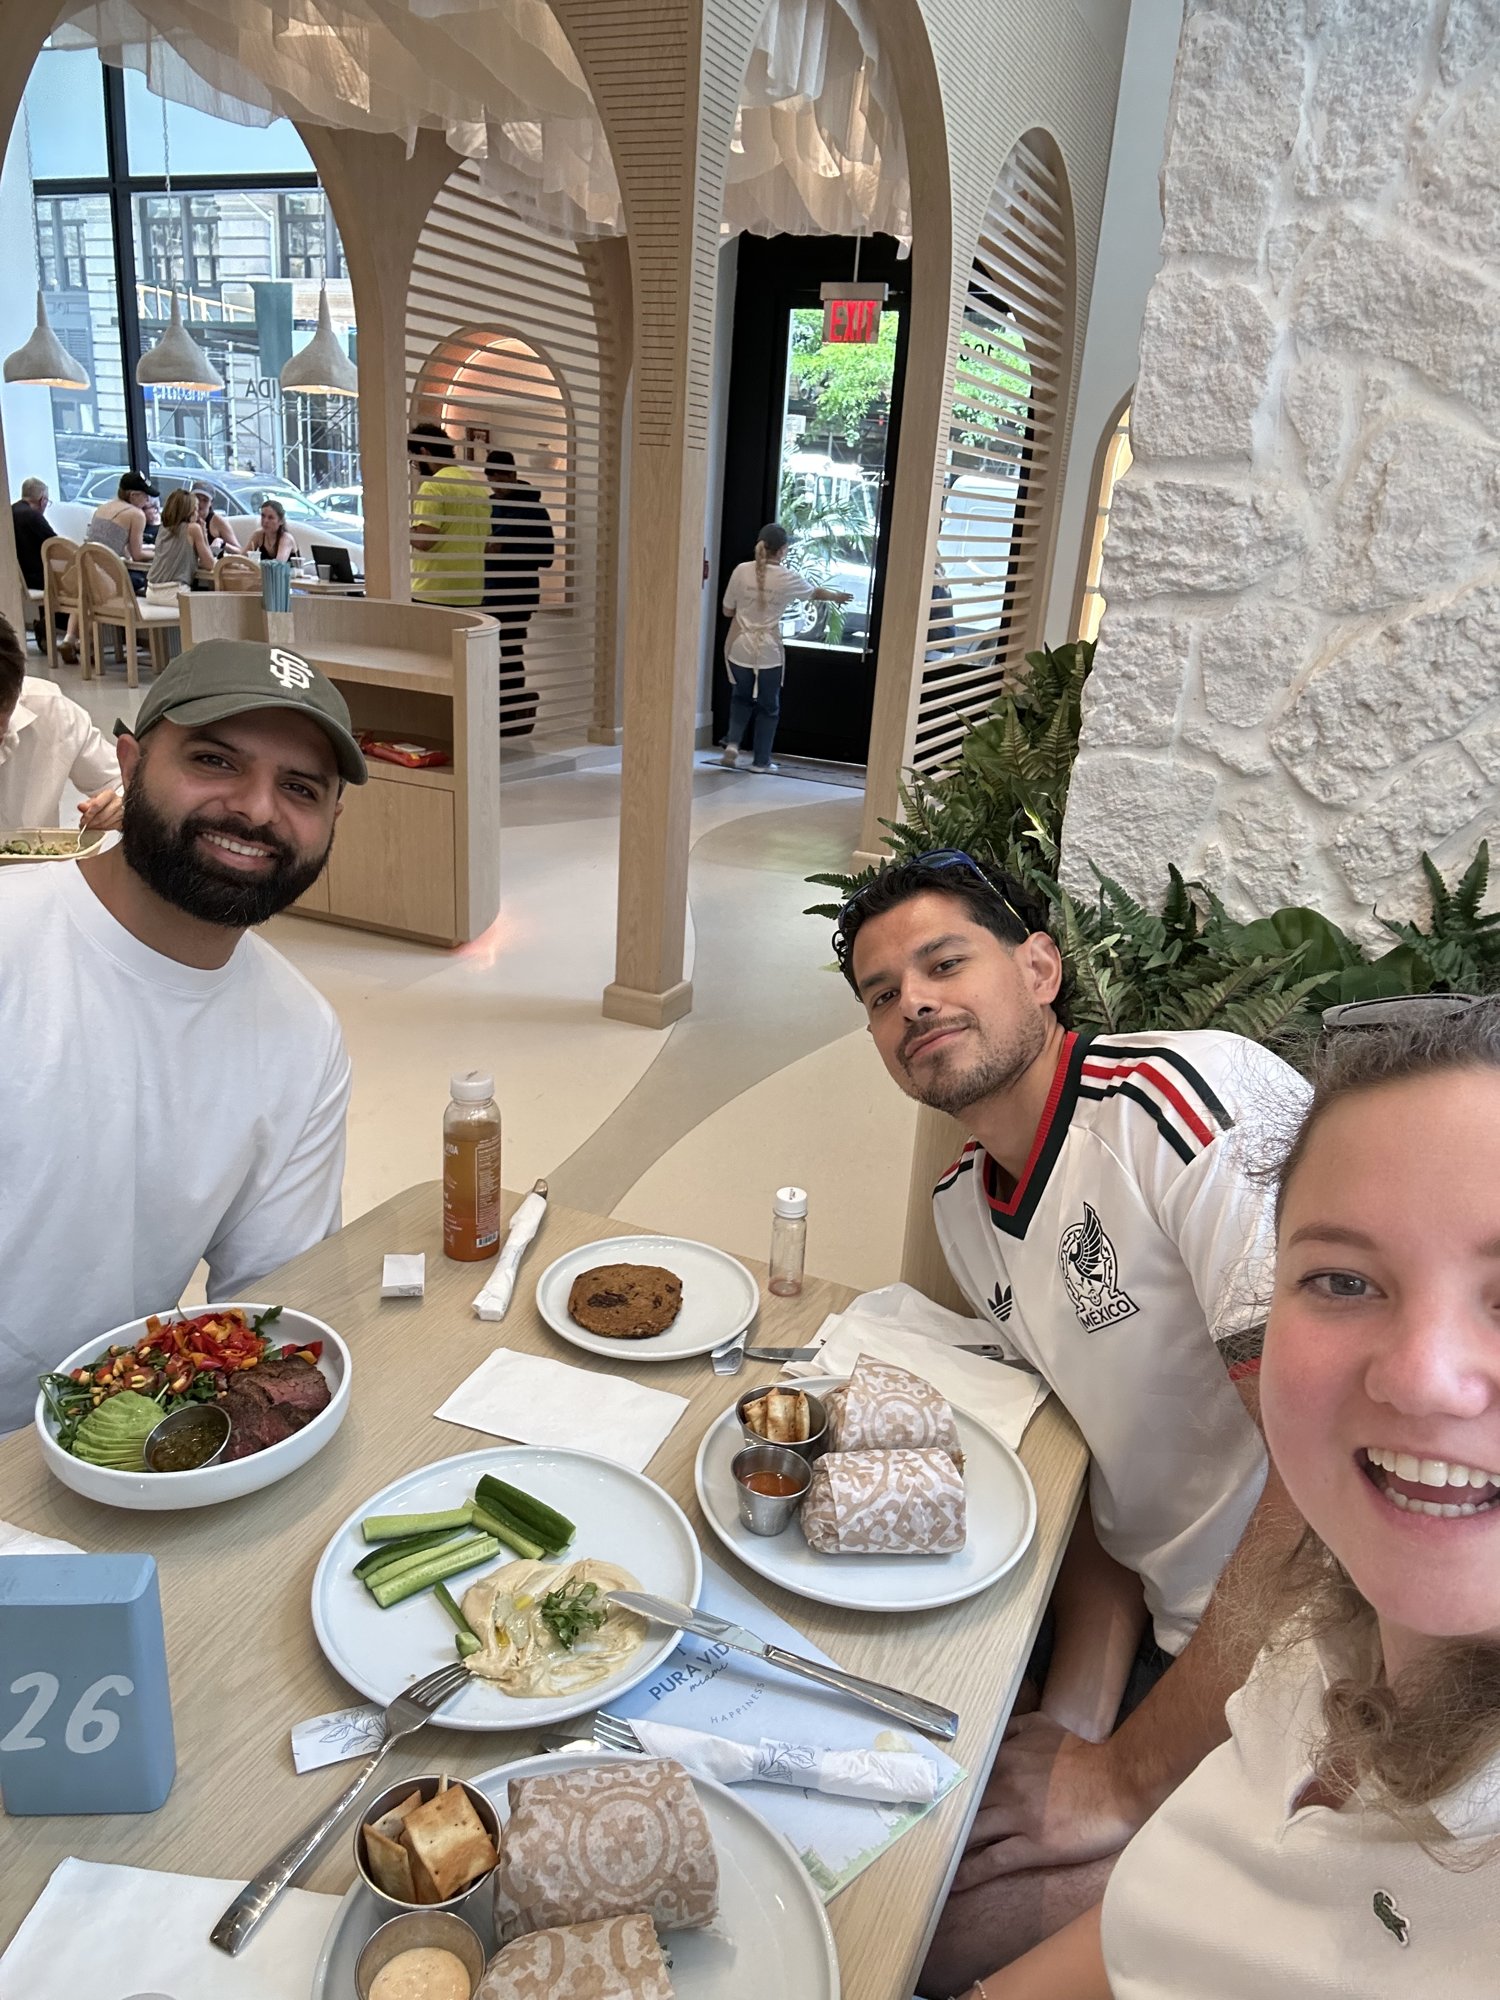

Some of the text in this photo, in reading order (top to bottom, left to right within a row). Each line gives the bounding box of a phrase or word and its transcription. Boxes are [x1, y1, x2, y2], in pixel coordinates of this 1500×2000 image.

[829, 300, 877, 342] EXIT
[1080, 1300, 1130, 1329] MÉXICO
[649, 1663, 702, 1701] PURA
[696, 1642, 730, 1665] VID
[690, 1662, 729, 1692] miami
[0, 1671, 135, 1754] 26
[710, 1682, 765, 1724] HAPPINESS
